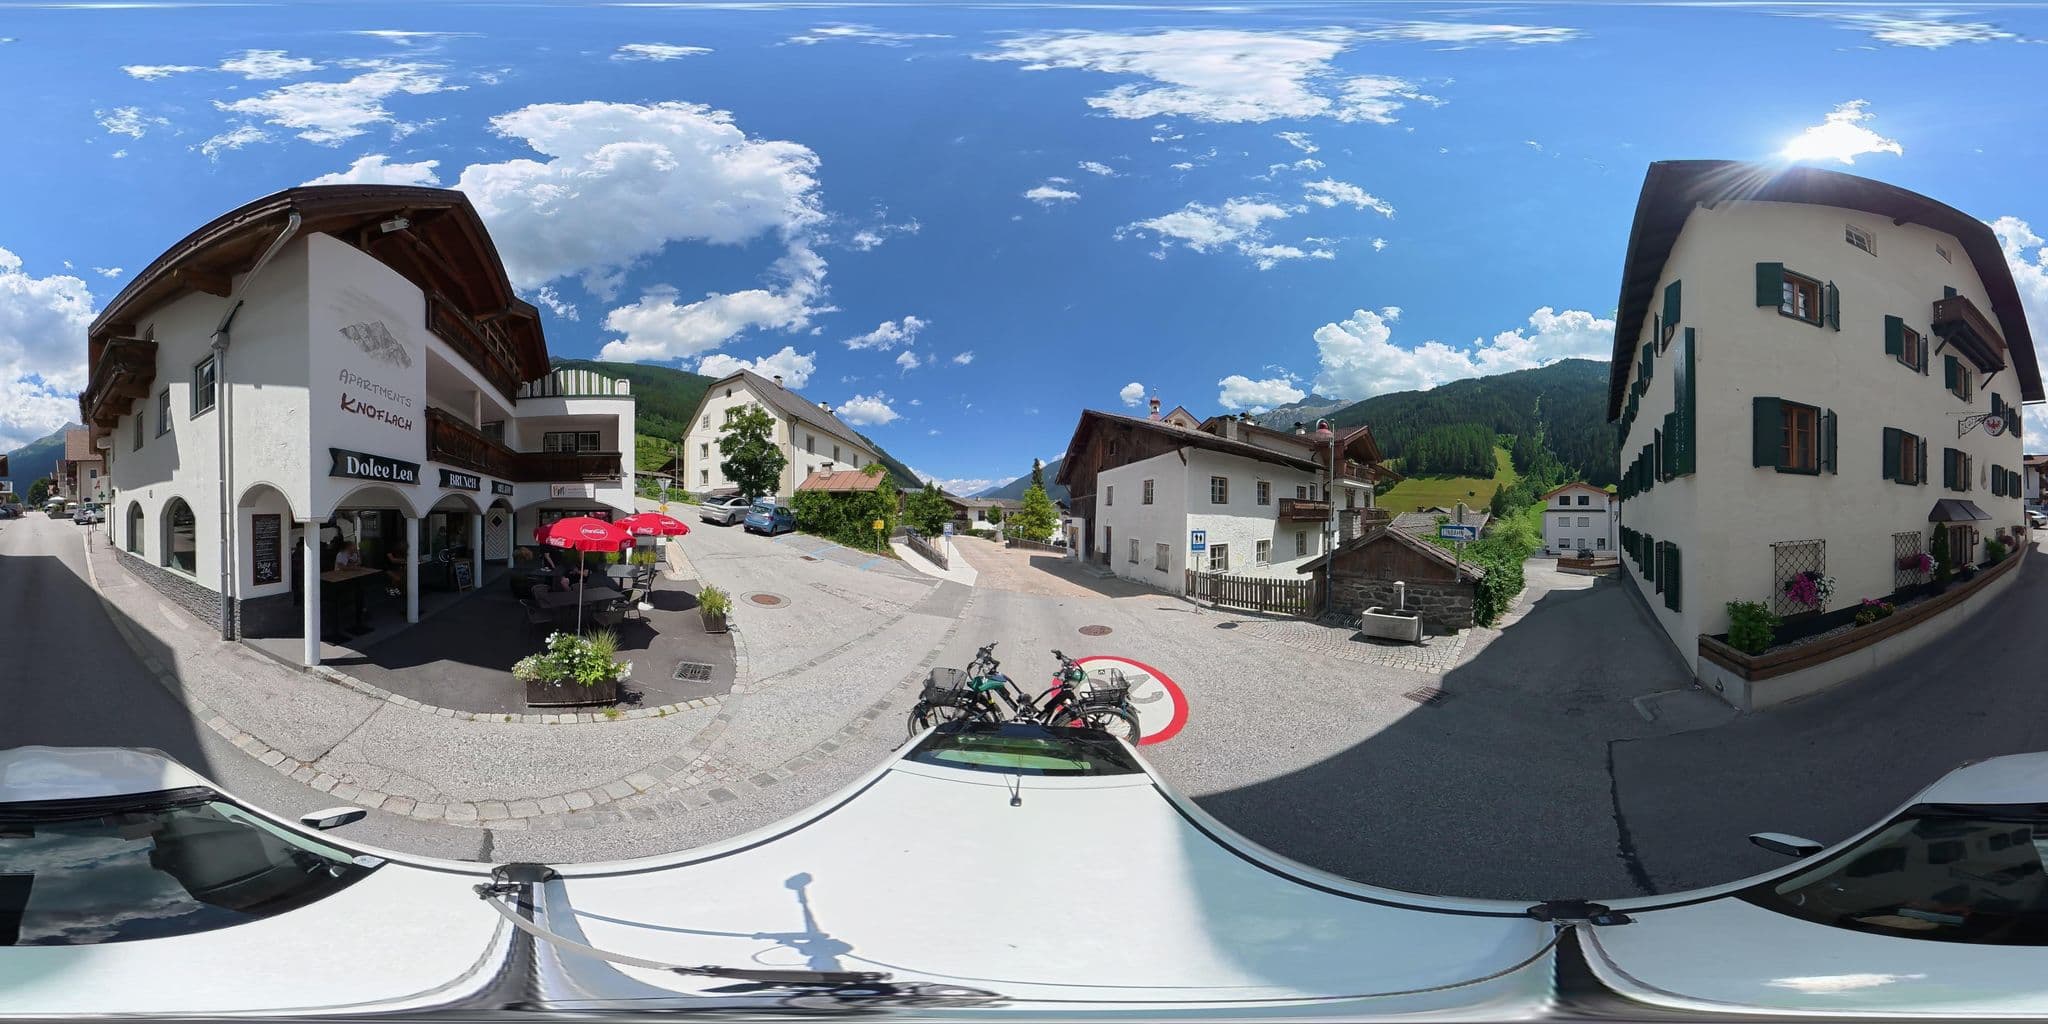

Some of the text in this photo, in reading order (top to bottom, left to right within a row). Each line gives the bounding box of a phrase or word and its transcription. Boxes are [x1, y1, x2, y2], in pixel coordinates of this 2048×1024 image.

[339, 369, 412, 407] APARTMENTS
[341, 392, 412, 431] KNOFLACH
[346, 456, 413, 481] Dolce Lea
